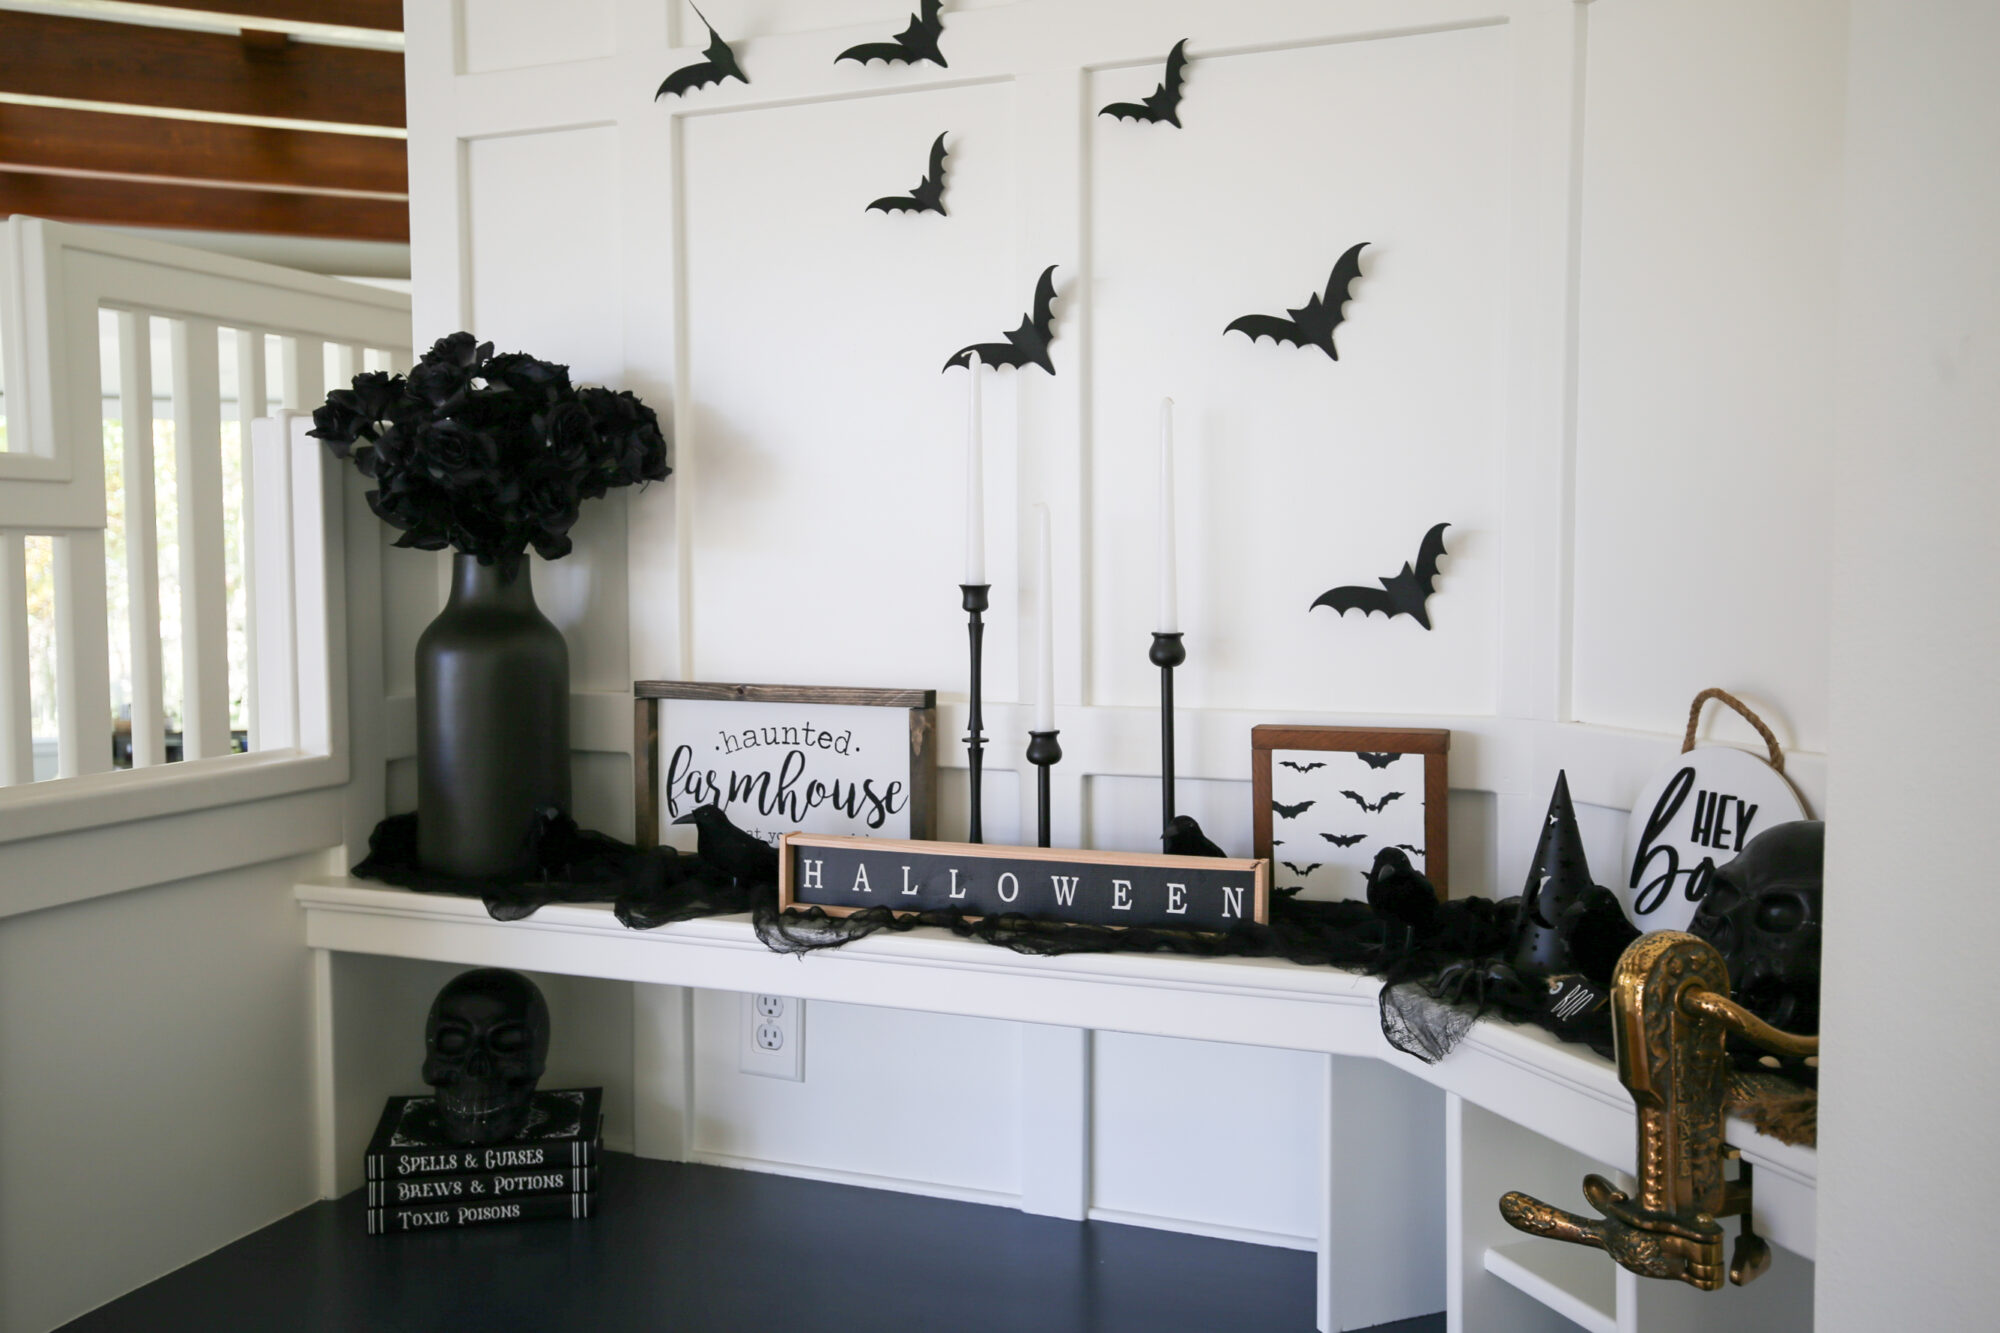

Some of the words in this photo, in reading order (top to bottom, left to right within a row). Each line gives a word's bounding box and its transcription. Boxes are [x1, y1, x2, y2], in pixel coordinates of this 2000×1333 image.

[666, 744, 909, 829] farmhouse
[1690, 790, 1758, 852] HEY
[803, 859, 1245, 919] HALLOWEEN
[398, 1154, 457, 1175] SPELLS
[465, 1153, 479, 1169] &
[397, 1180, 463, 1200] BREWS
[471, 1180, 485, 1194] &
[493, 1173, 565, 1195] POTIONS
[398, 1210, 450, 1230] TOXIC
[458, 1204, 521, 1225] POISONS
